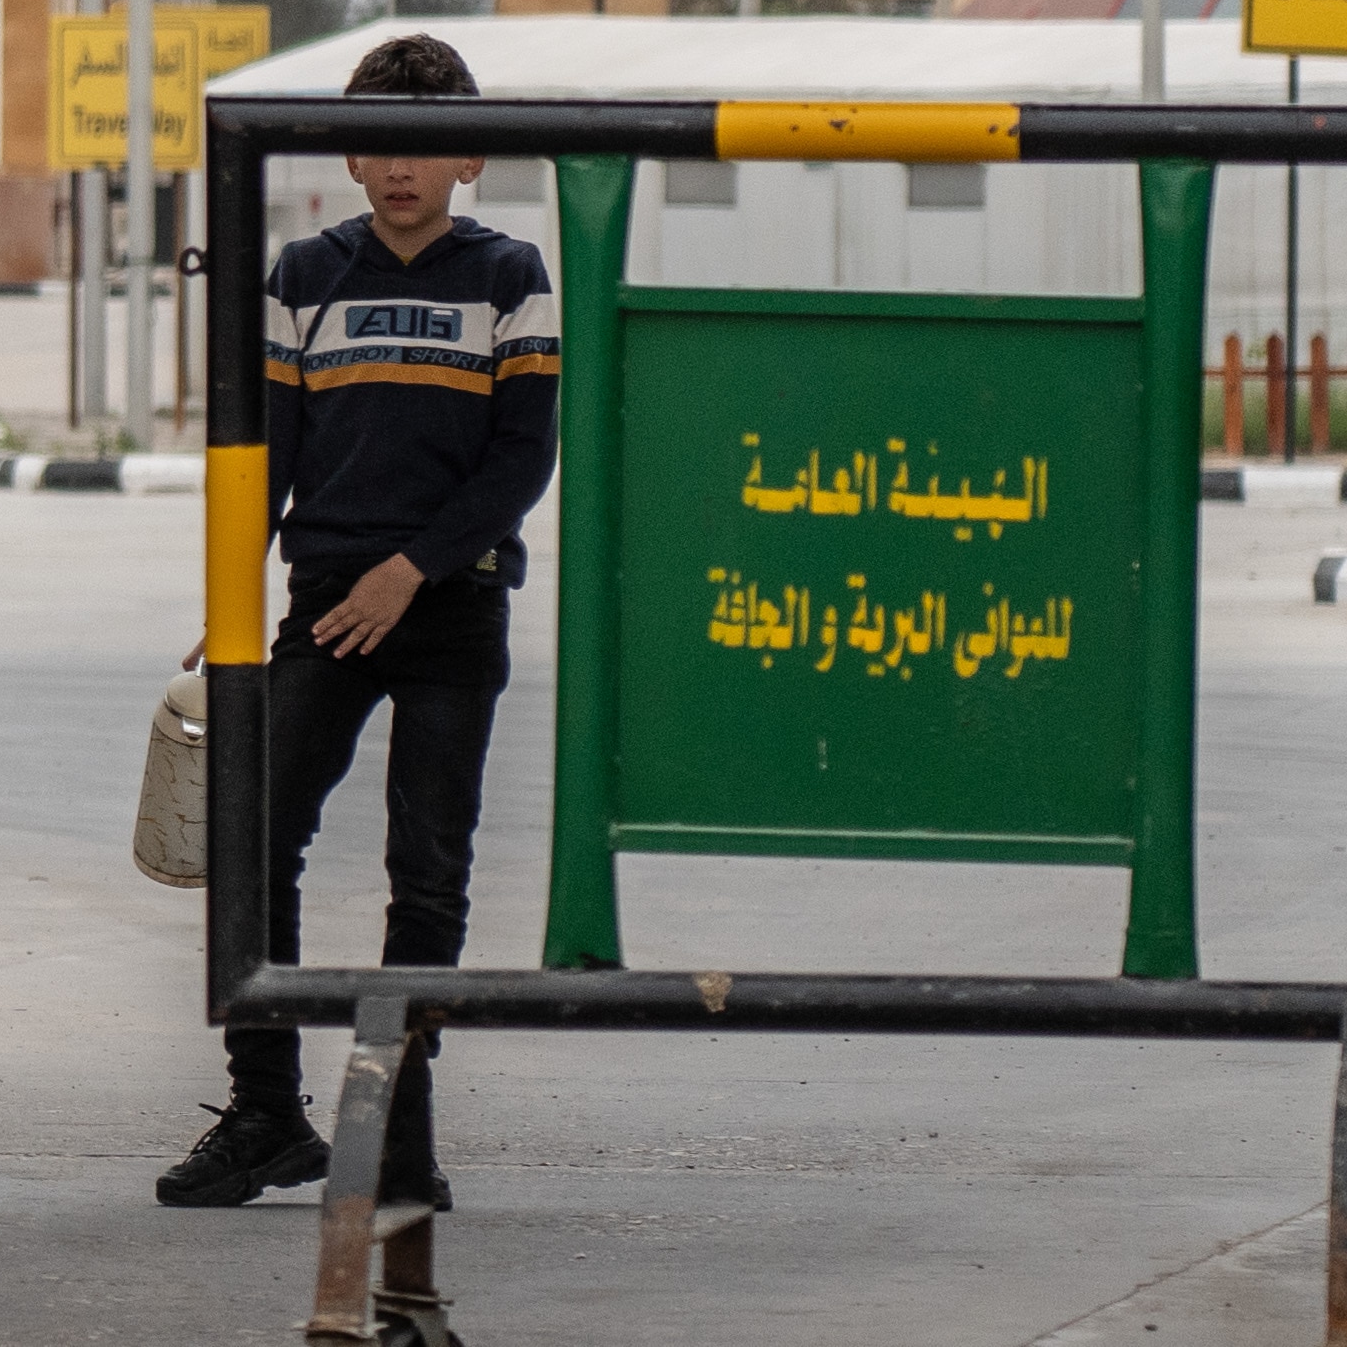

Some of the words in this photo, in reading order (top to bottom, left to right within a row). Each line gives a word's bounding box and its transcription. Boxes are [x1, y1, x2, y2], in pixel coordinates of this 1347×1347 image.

[71, 104, 130, 139] Trave
[350, 346, 396, 363] BOY
[408, 348, 488, 371] SHORT
[741, 432, 878, 516] العامة
[707, 565, 810, 671] الجافة
[846, 572, 947, 682] البرية
